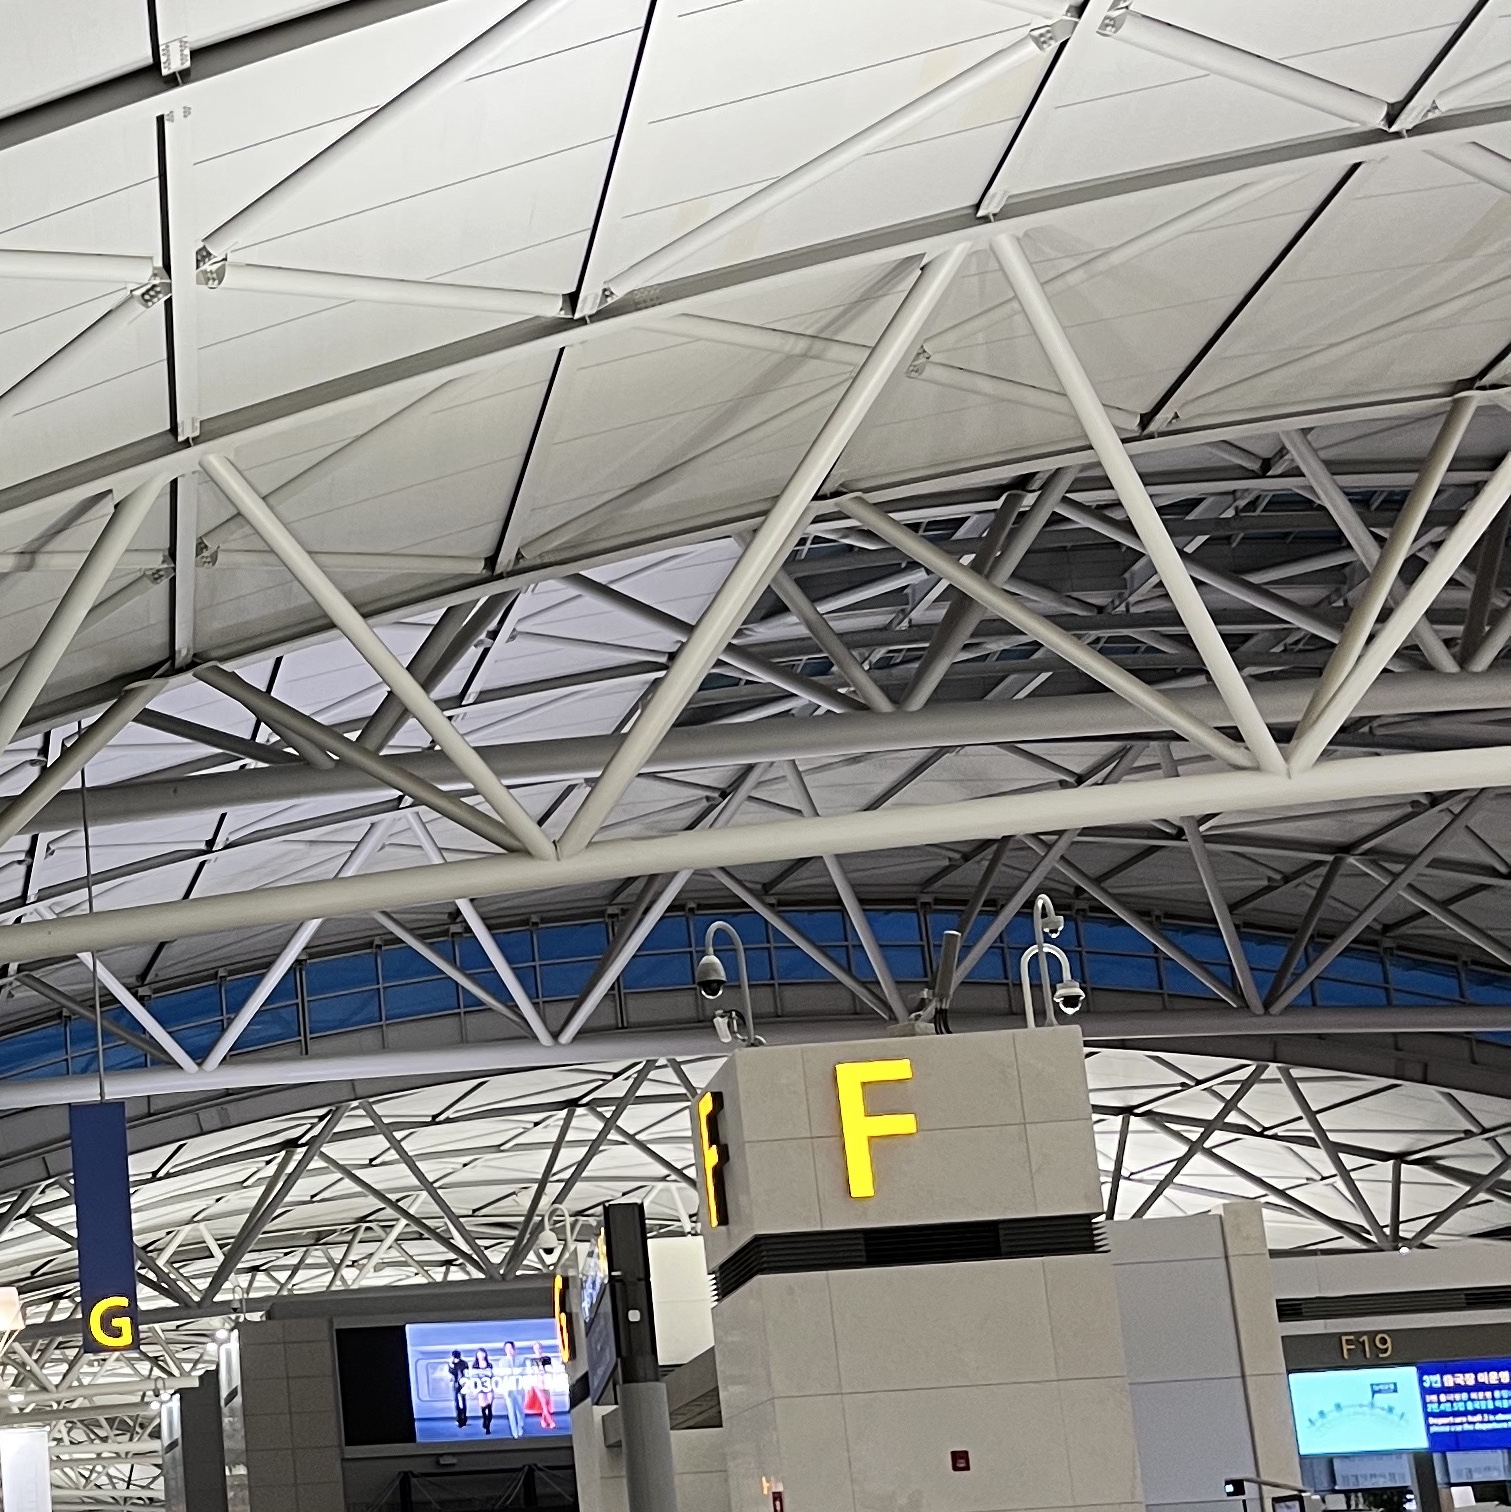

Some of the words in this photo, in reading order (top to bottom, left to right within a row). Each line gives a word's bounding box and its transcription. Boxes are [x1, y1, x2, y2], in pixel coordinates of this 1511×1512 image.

[835, 1058, 918, 1198] F
[89, 1296, 133, 1347] G
[1341, 1333, 1393, 1360] F19
